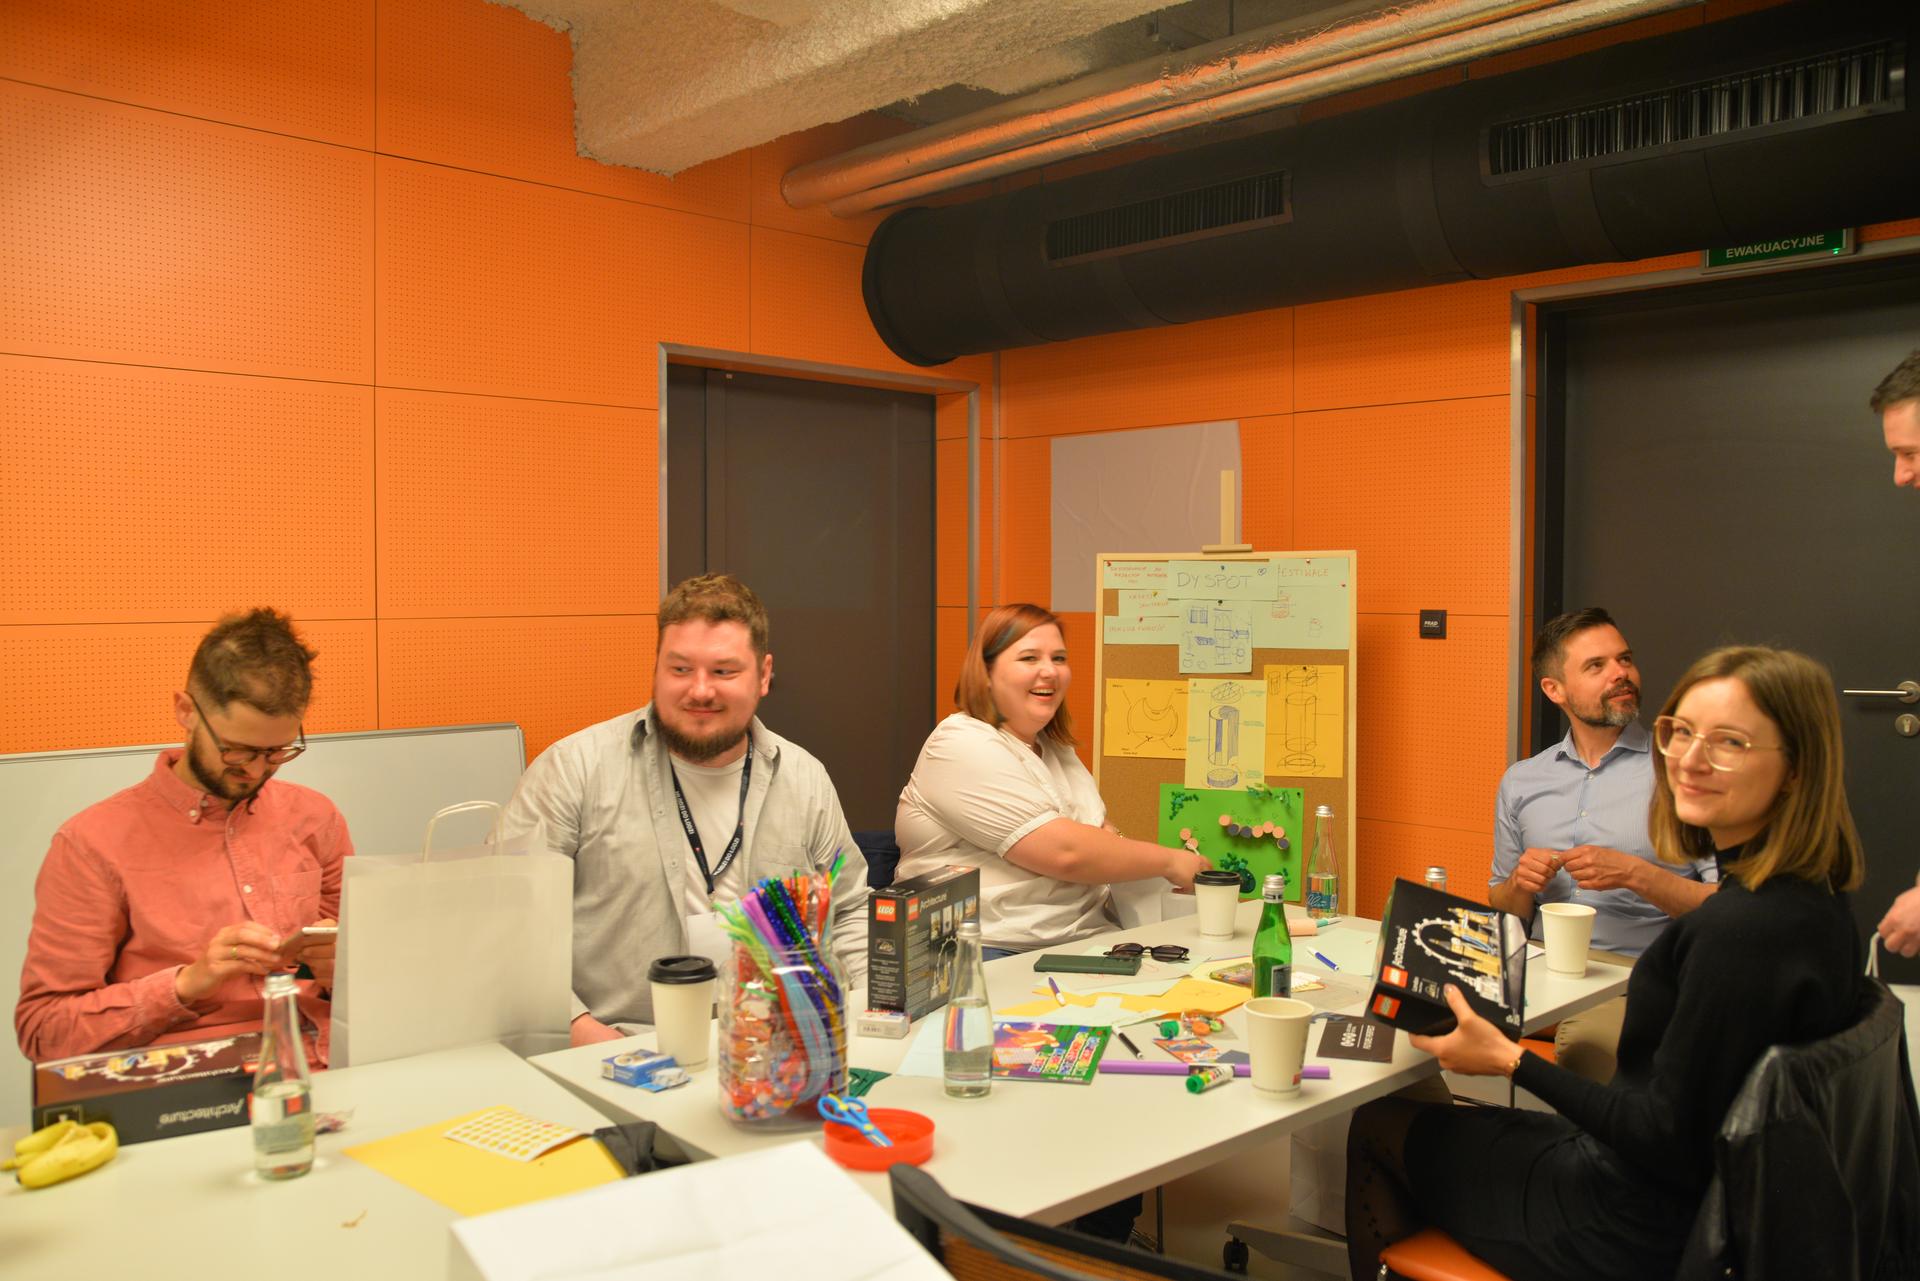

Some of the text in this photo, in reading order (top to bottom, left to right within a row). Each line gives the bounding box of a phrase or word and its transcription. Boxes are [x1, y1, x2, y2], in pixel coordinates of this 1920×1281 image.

[1726, 234, 1825, 258] EWAKUACYJNE
[878, 905, 895, 915] LEGO
[159, 1098, 245, 1125] Architecture
